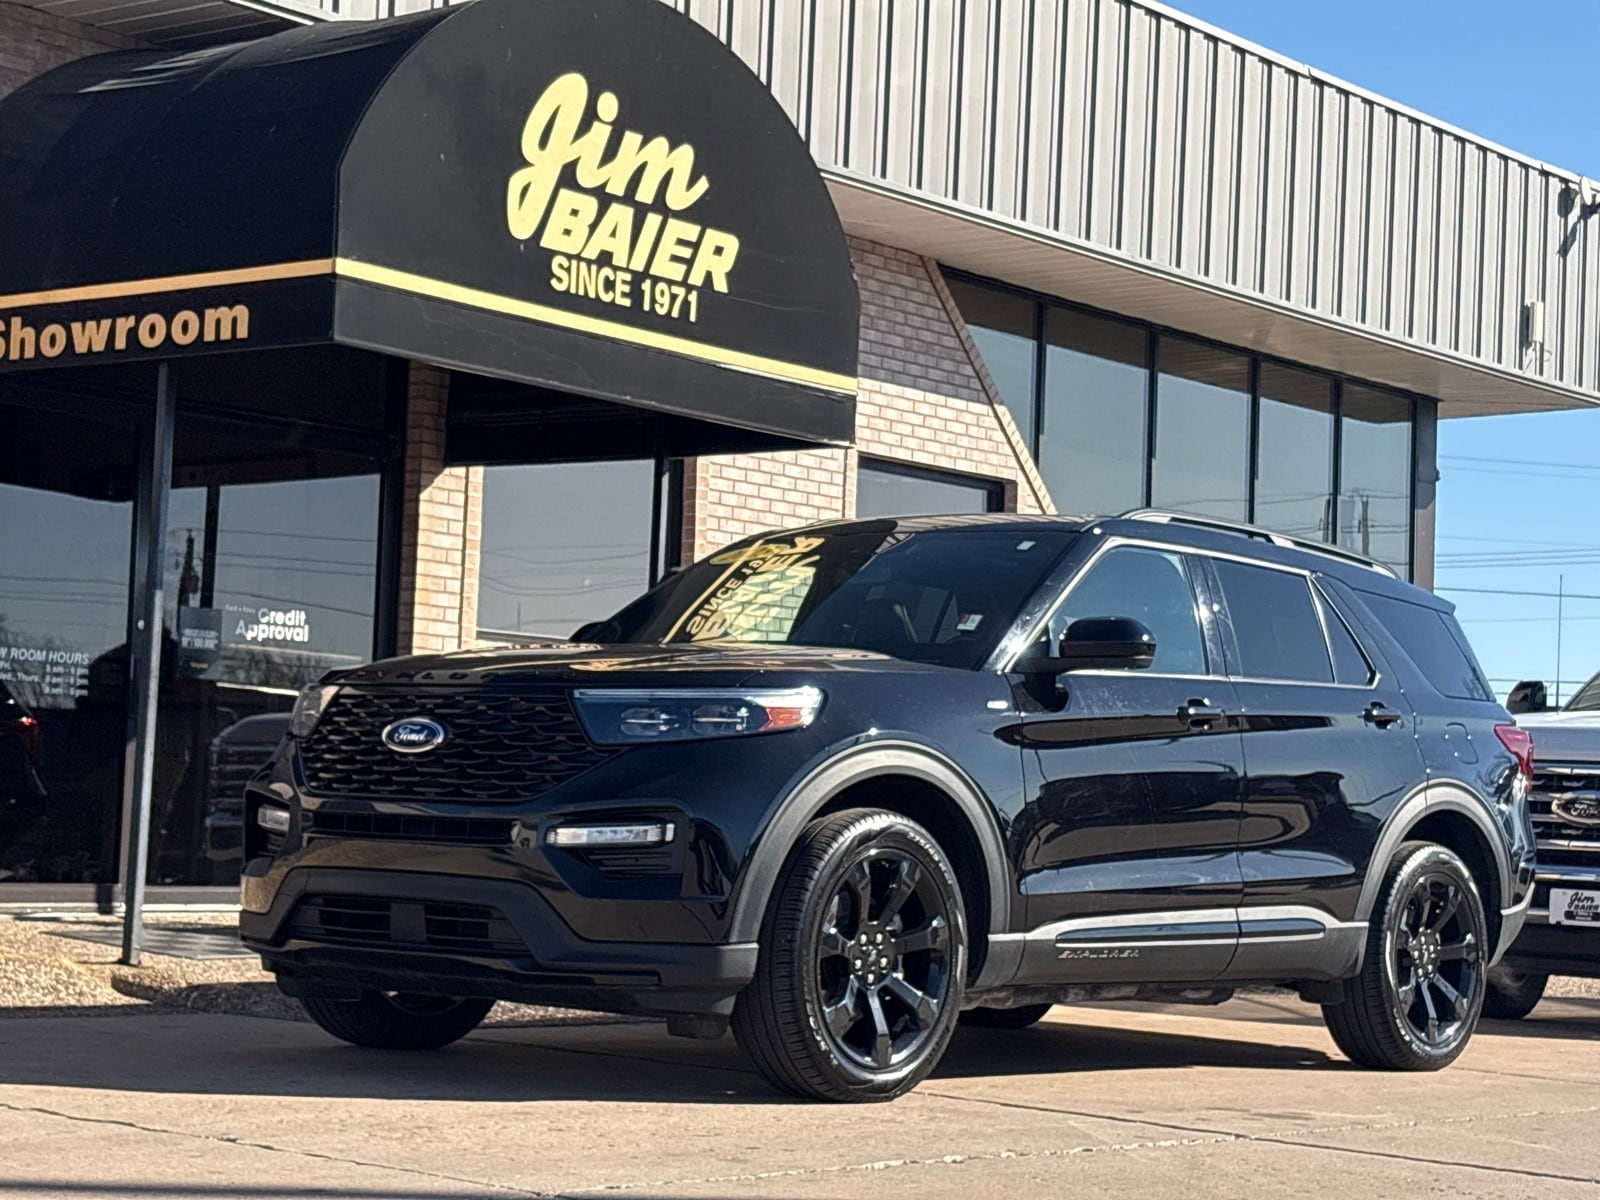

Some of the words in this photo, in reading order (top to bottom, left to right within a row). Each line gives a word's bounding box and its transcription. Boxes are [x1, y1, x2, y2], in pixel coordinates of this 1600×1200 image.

[507, 72, 710, 240] Jim
[539, 188, 740, 293] BAIER
[550, 255, 632, 308] SINCE
[641, 278, 698, 323] 1971
[0, 304, 250, 361] howroom
[258, 607, 306, 627] Credit
[235, 619, 310, 642] Approval
[10, 647, 46, 661] ROOM
[48, 651, 90, 665] HOURS
[393, 724, 429, 744] Ford
[1567, 891, 1596, 909] Jim
